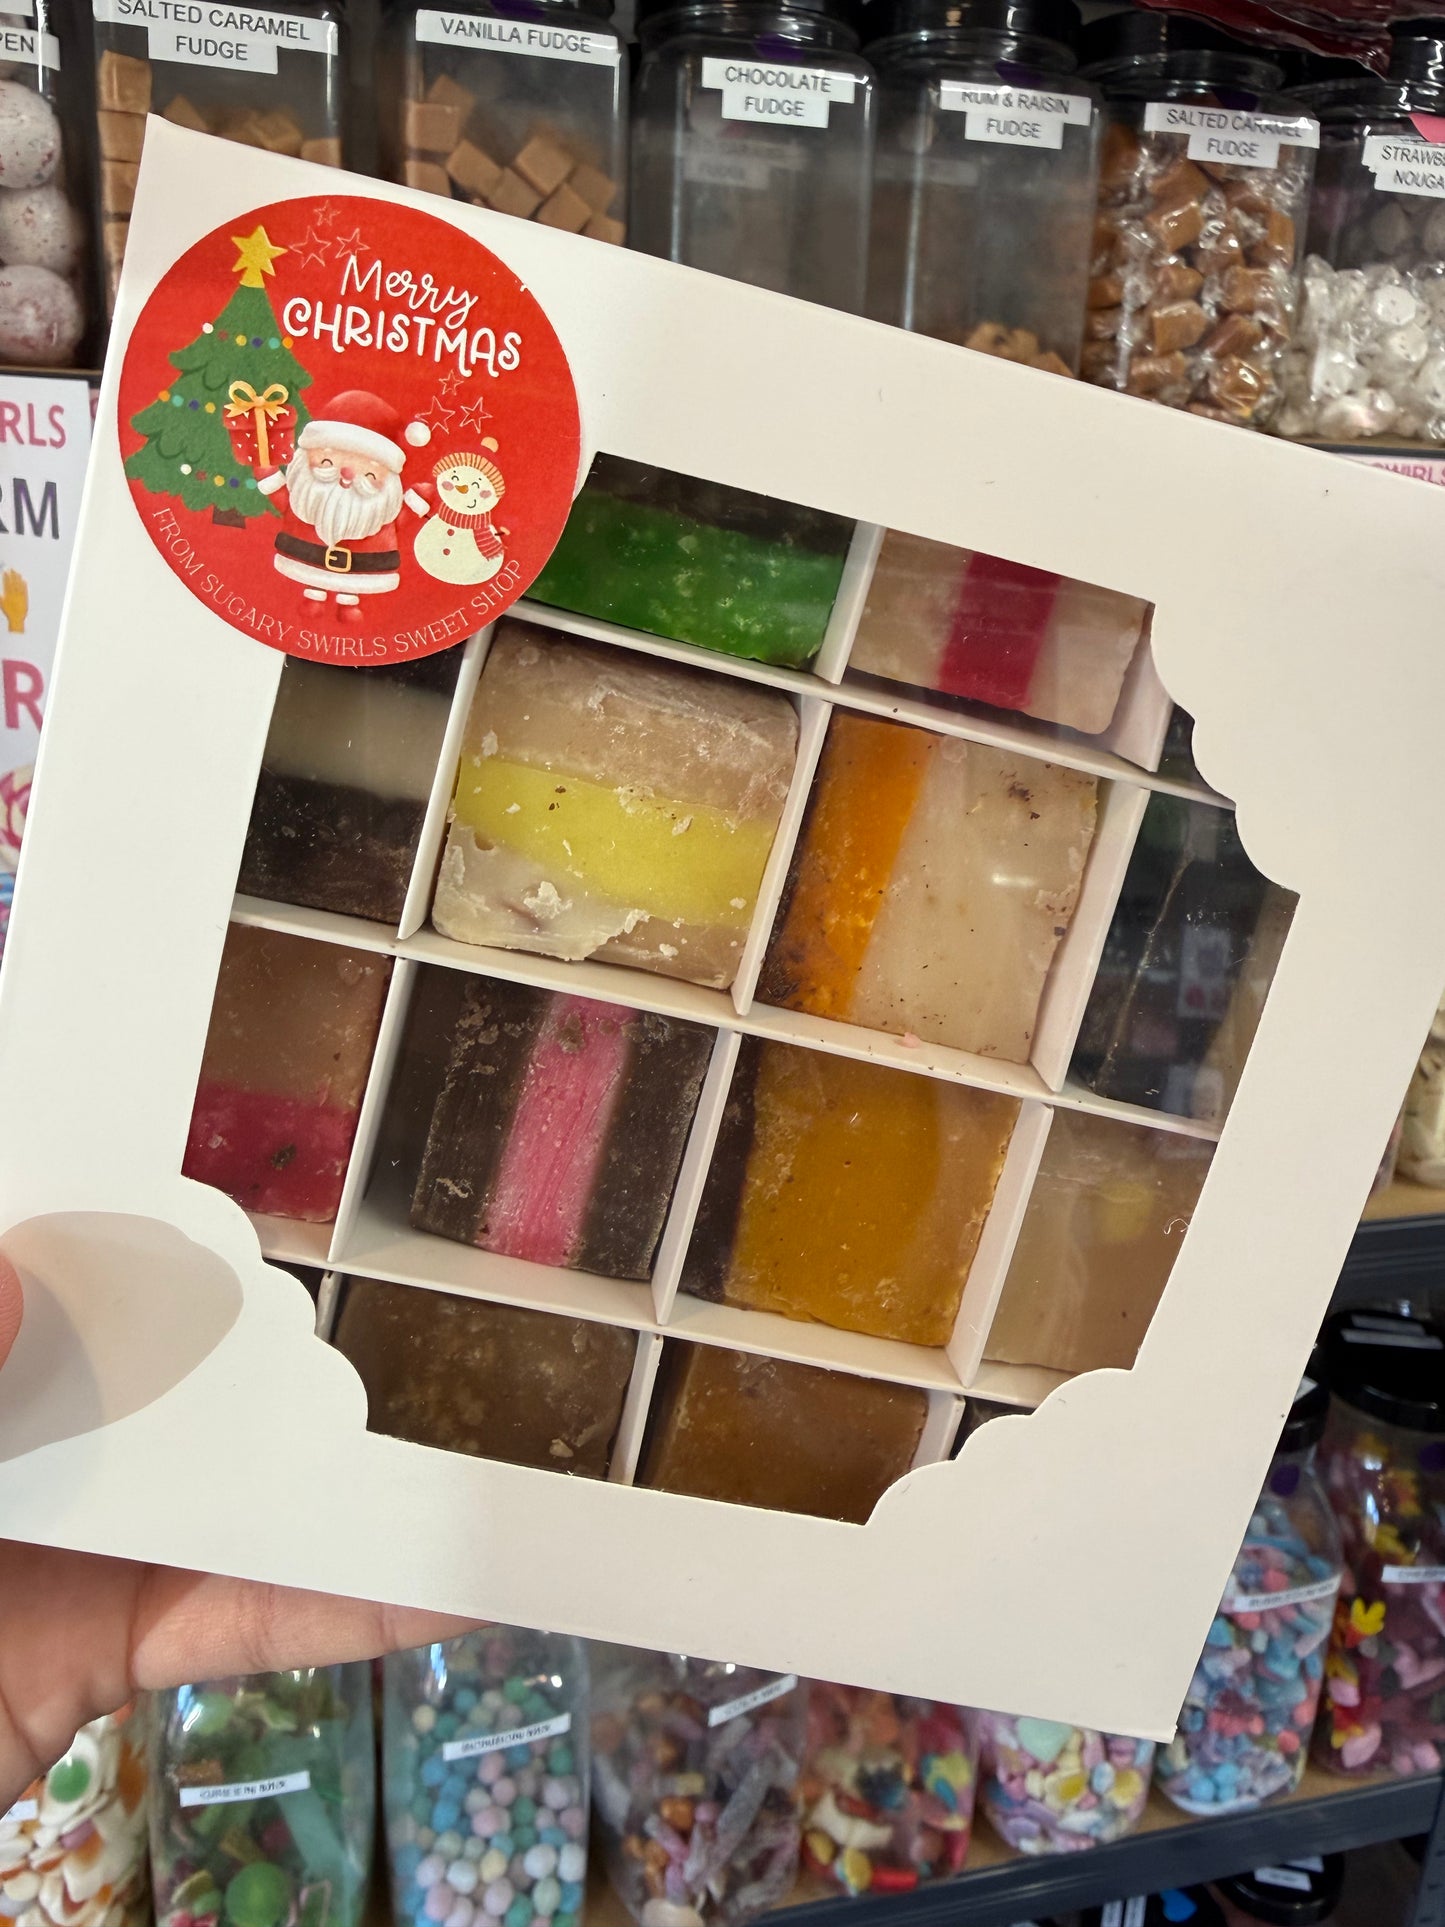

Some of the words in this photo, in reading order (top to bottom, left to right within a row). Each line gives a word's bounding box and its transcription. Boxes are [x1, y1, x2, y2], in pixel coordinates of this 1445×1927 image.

[118, 0, 202, 24] SALTED
[208, 9, 310, 41] CARAMEL
[0, 32, 34, 53] EN
[176, 35, 248, 61] FUDGE
[440, 17, 522, 44] VANILLA
[527, 29, 592, 54] FUDGE
[725, 66, 832, 93] CHOCOLATE
[744, 96, 805, 117] FUDGE
[962, 91, 999, 106] RUM
[1002, 93, 1013, 108] &
[1018, 94, 1070, 114] RAISIN
[986, 118, 1042, 139] FUDGE
[1166, 109, 1228, 129] SALTED
[1207, 137, 1261, 159] FUDGE
[340, 254, 479, 330] Merry
[283, 297, 522, 378] CHRISTMAS
[0, 401, 66, 449] RLS
[0, 477, 59, 540] M
[152, 508, 205, 576] FROM
[200, 574, 293, 641] SUGARY
[298, 630, 387, 657] SWIRLS
[394, 607, 469, 653] SWEET
[471, 559, 521, 616] SHOP
